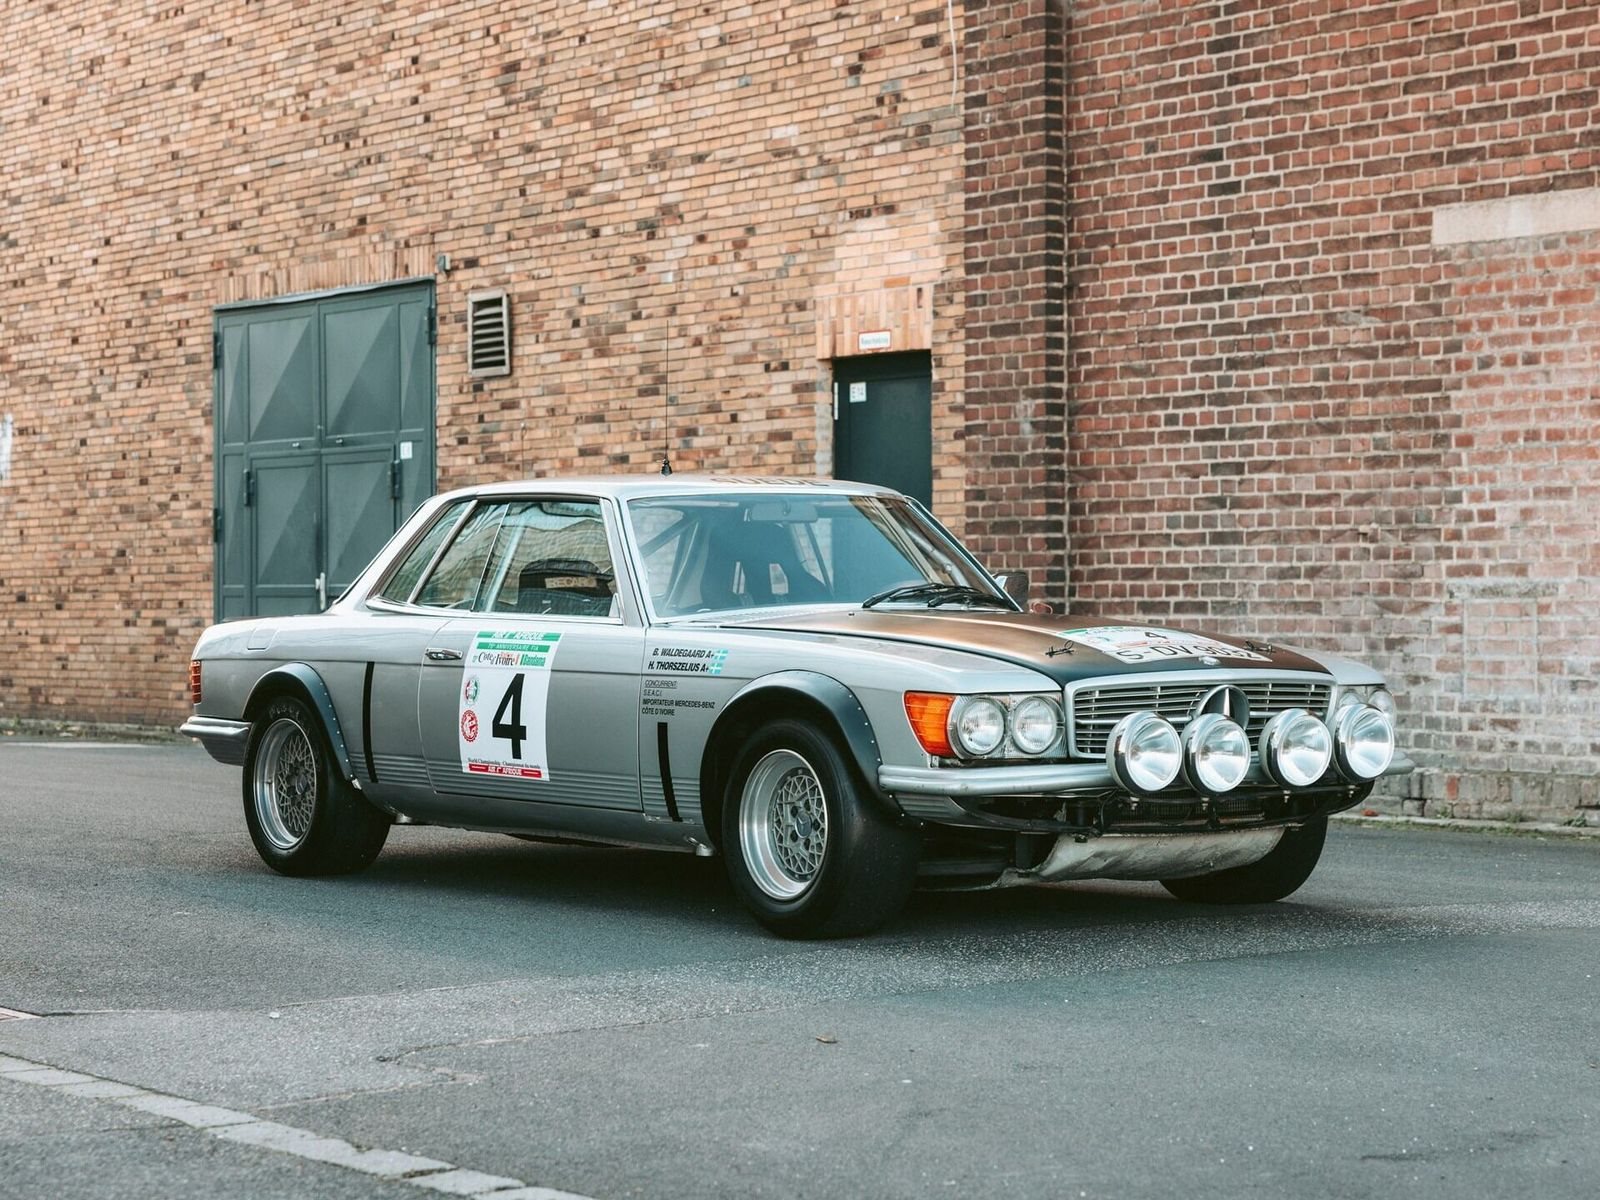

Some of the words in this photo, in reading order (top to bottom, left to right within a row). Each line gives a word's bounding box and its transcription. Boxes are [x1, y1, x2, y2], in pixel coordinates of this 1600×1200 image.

[1144, 631, 1168, 640] 4
[652, 648, 659, 656] B.
[660, 648, 705, 659] WALDEGAARD
[647, 661, 654, 670] H.
[656, 661, 701, 672] THORSZELIUS
[642, 698, 674, 707] IMPORTATEUR
[674, 699, 715, 709] MERCEDES-BENZ
[492, 673, 527, 760] 4
